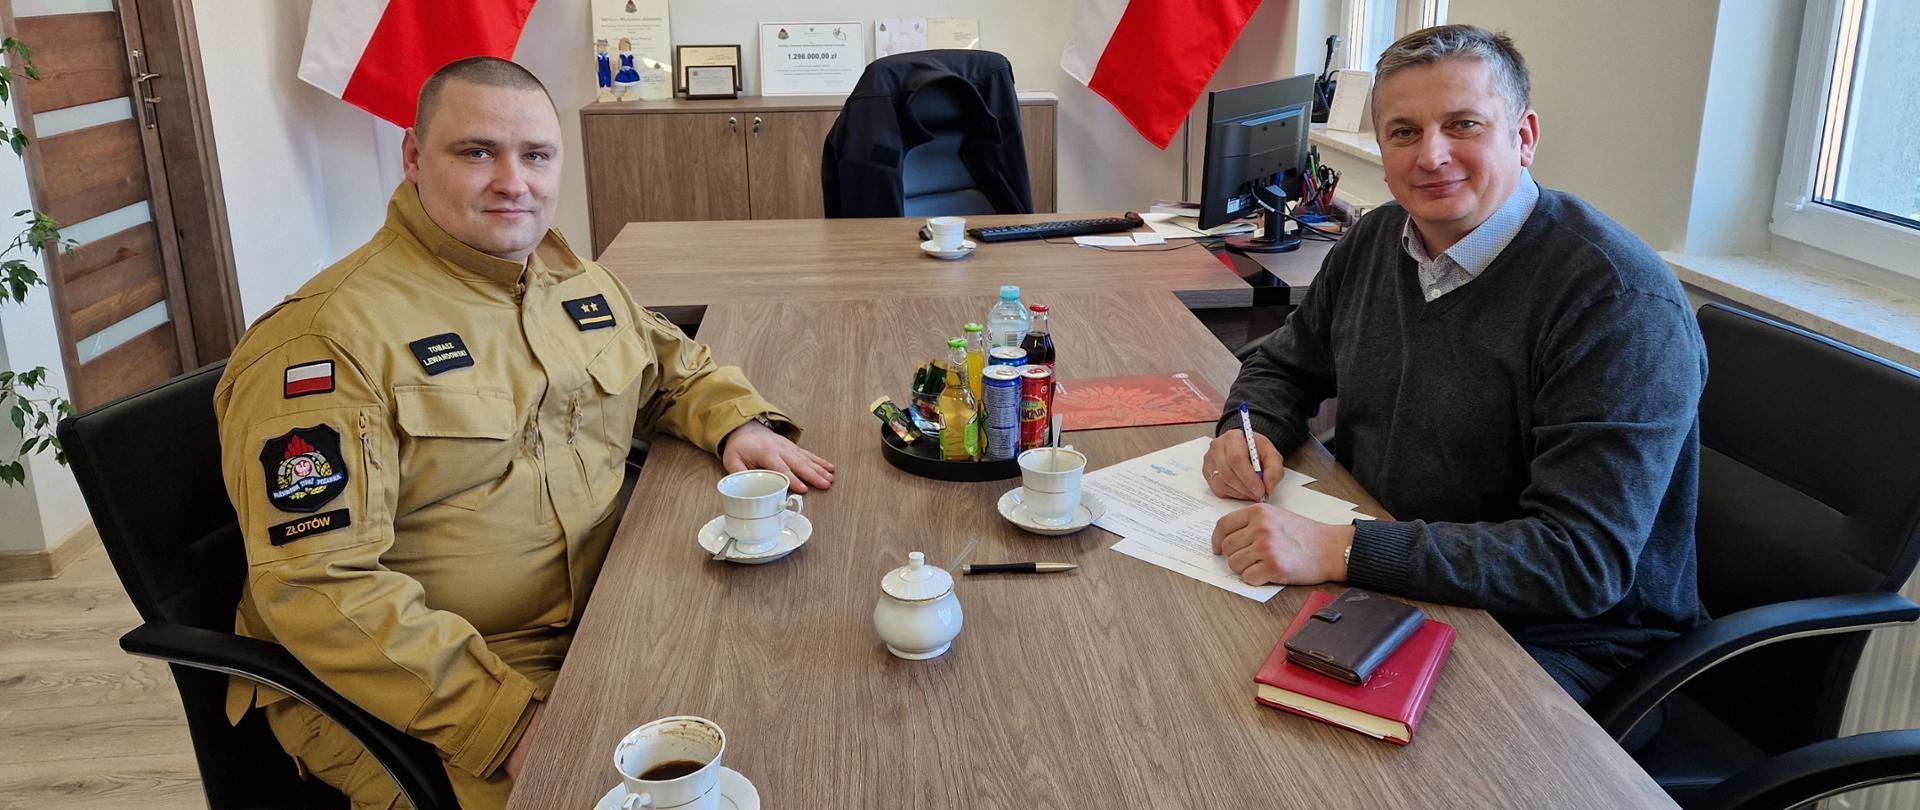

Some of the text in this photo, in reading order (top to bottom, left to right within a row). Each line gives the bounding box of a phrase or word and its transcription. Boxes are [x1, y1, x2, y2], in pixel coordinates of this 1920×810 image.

[427, 342, 455, 353] TOMASZ
[422, 350, 468, 366] LEWANDOWSKI
[285, 516, 331, 537] ZŁOTÓW
